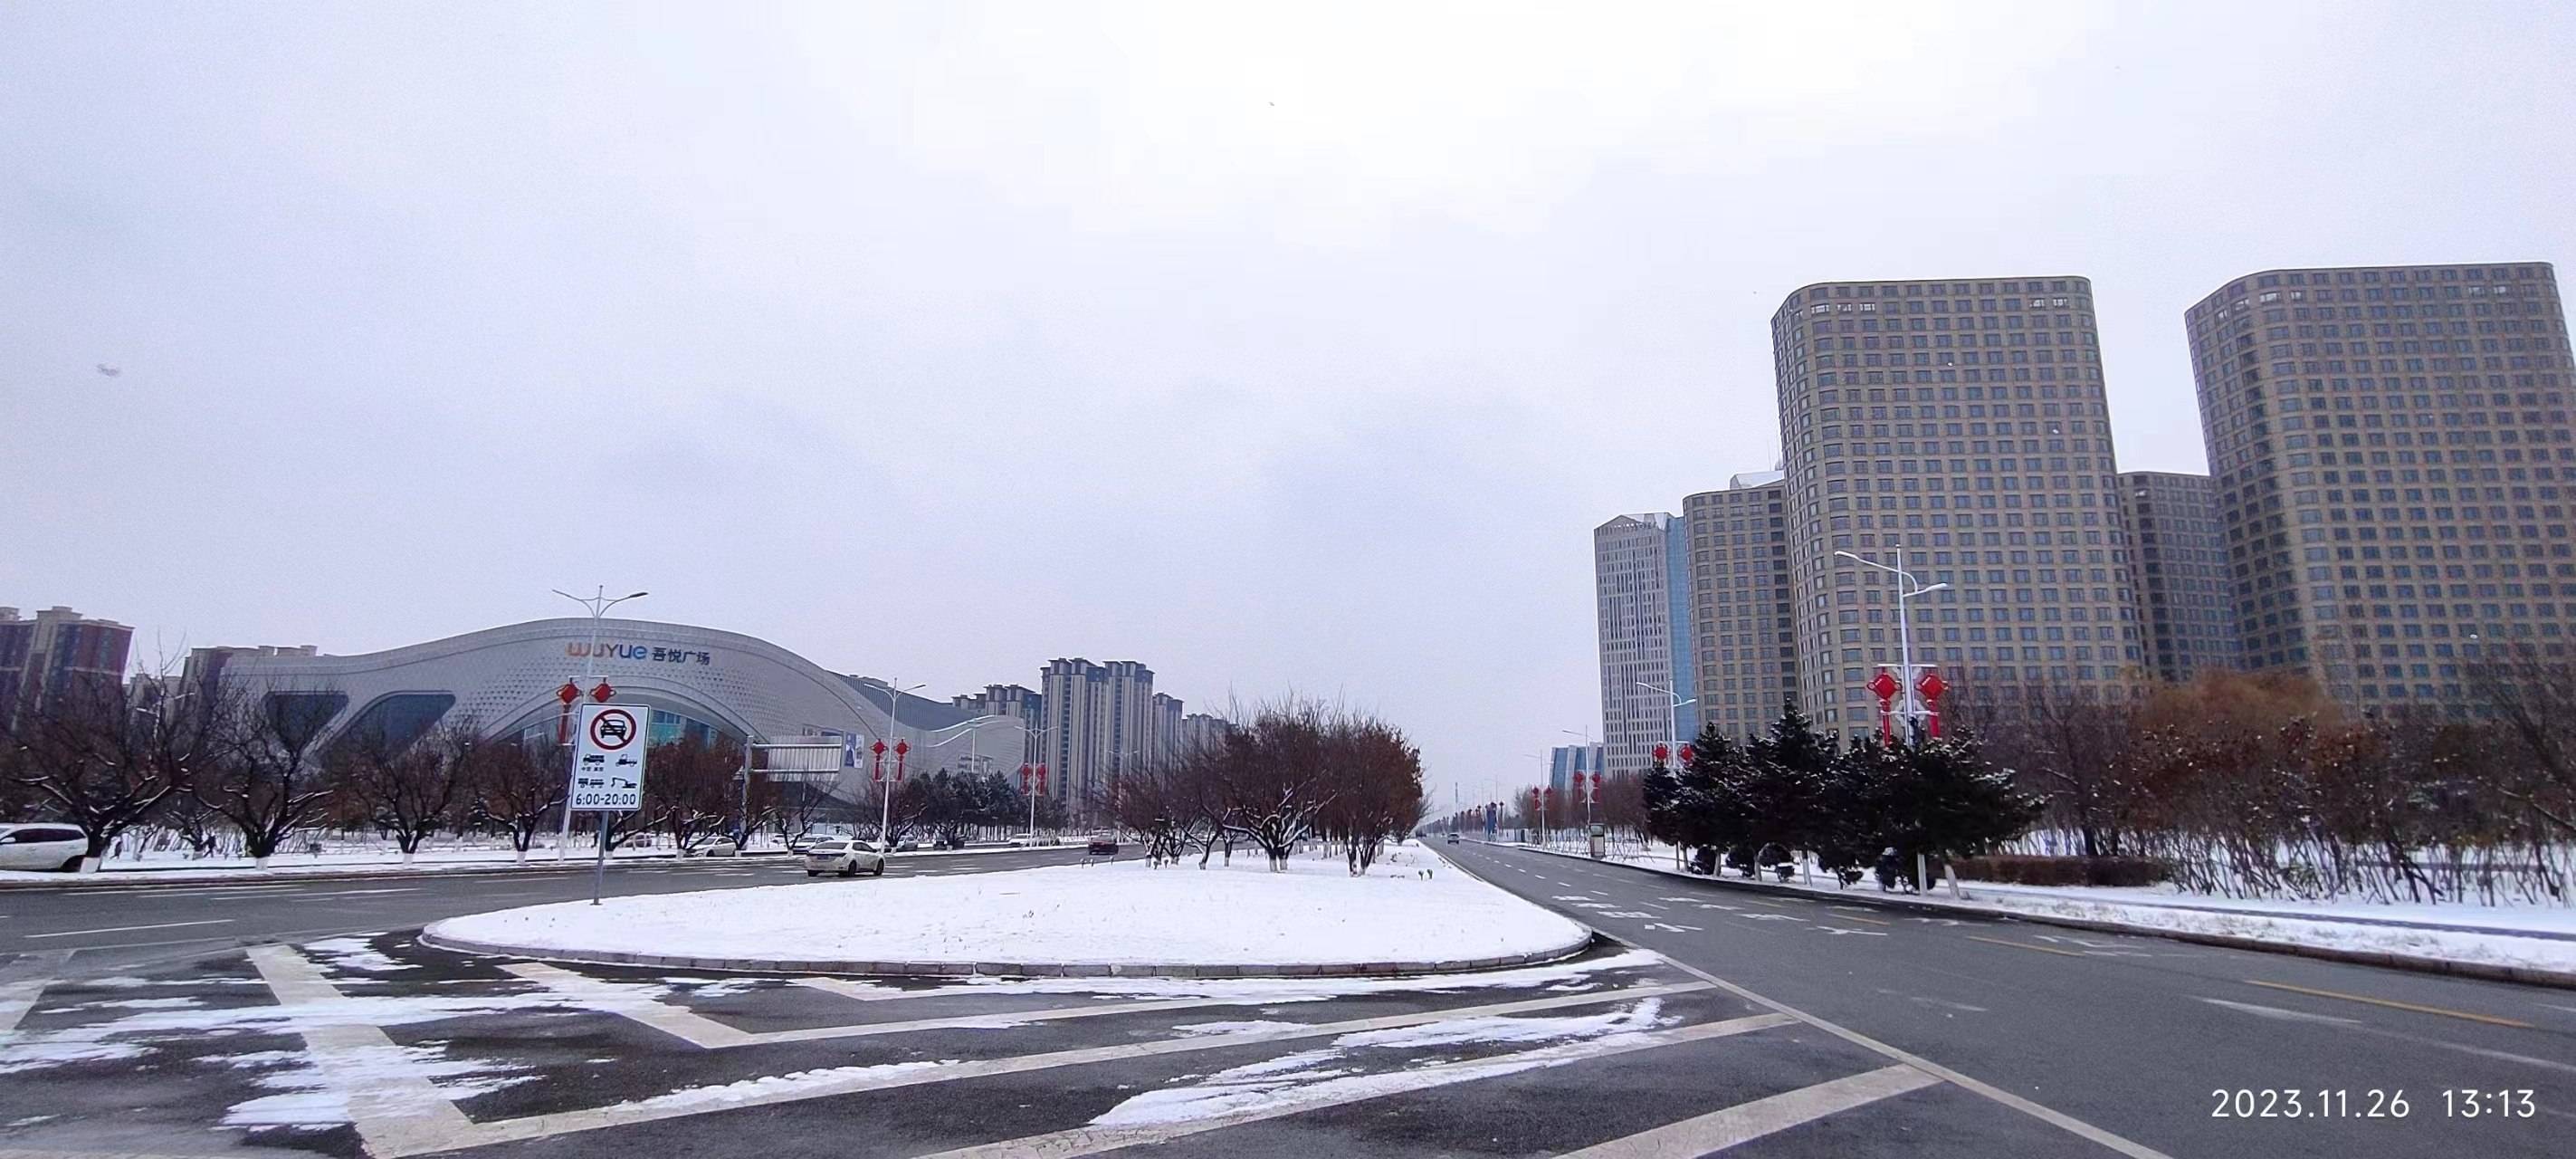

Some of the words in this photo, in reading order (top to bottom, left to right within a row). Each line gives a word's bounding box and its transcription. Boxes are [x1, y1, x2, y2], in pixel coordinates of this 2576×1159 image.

[652, 647, 711, 666] 吾悦广场
[576, 793, 636, 805] 6:00-20:00
